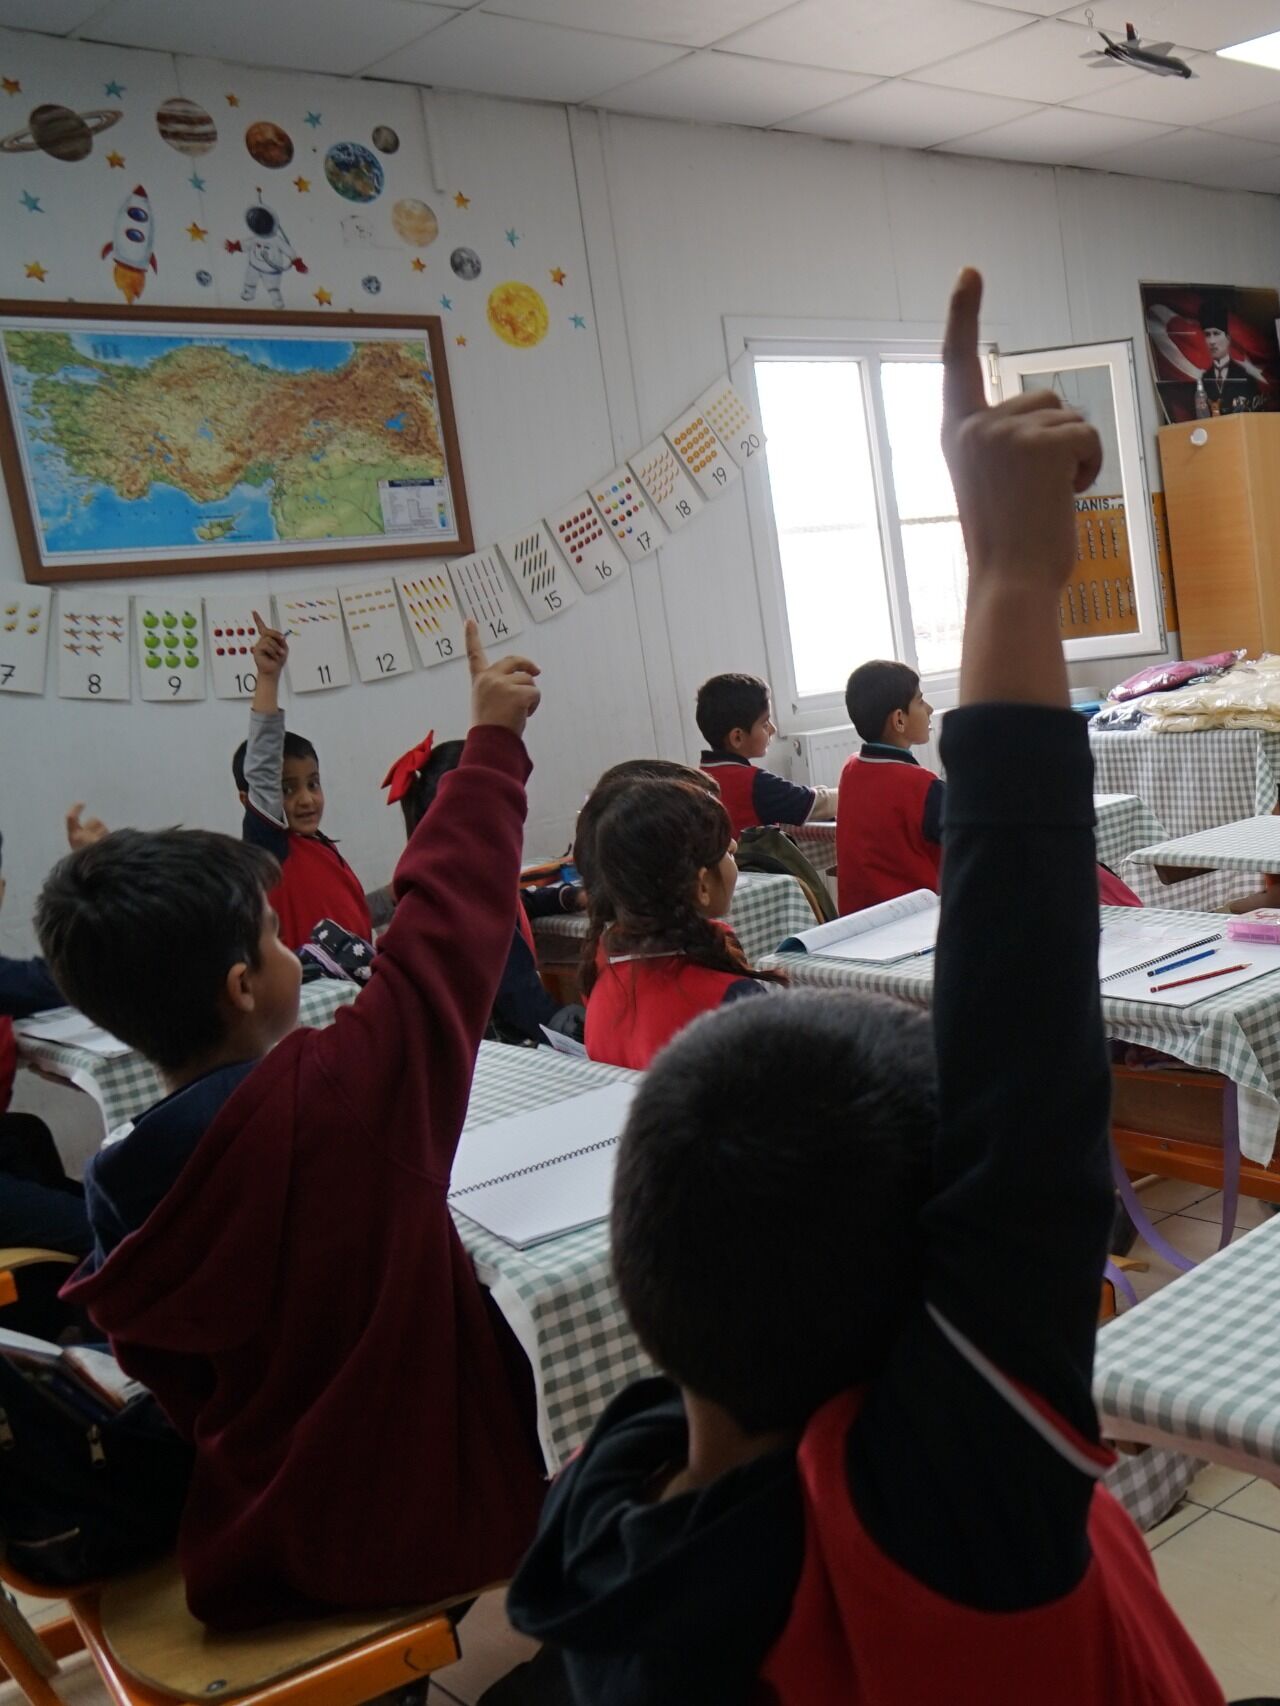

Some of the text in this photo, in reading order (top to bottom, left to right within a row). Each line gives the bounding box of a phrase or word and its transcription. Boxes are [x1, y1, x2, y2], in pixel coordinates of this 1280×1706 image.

[740, 434, 760, 457] 20
[711, 467, 728, 486] 19
[675, 500, 692, 518] 18
[636, 530, 652, 551] 17
[595, 563, 613, 581] 16
[544, 591, 562, 610] 15
[489, 619, 509, 639] 14
[435, 637, 453, 658] 13
[375, 653, 397, 673] 12
[0, 665, 16, 685] 7
[88, 674, 101, 694] 8
[234, 673, 257, 694] 10
[317, 665, 332, 684] 11
[168, 676, 182, 695] 9
